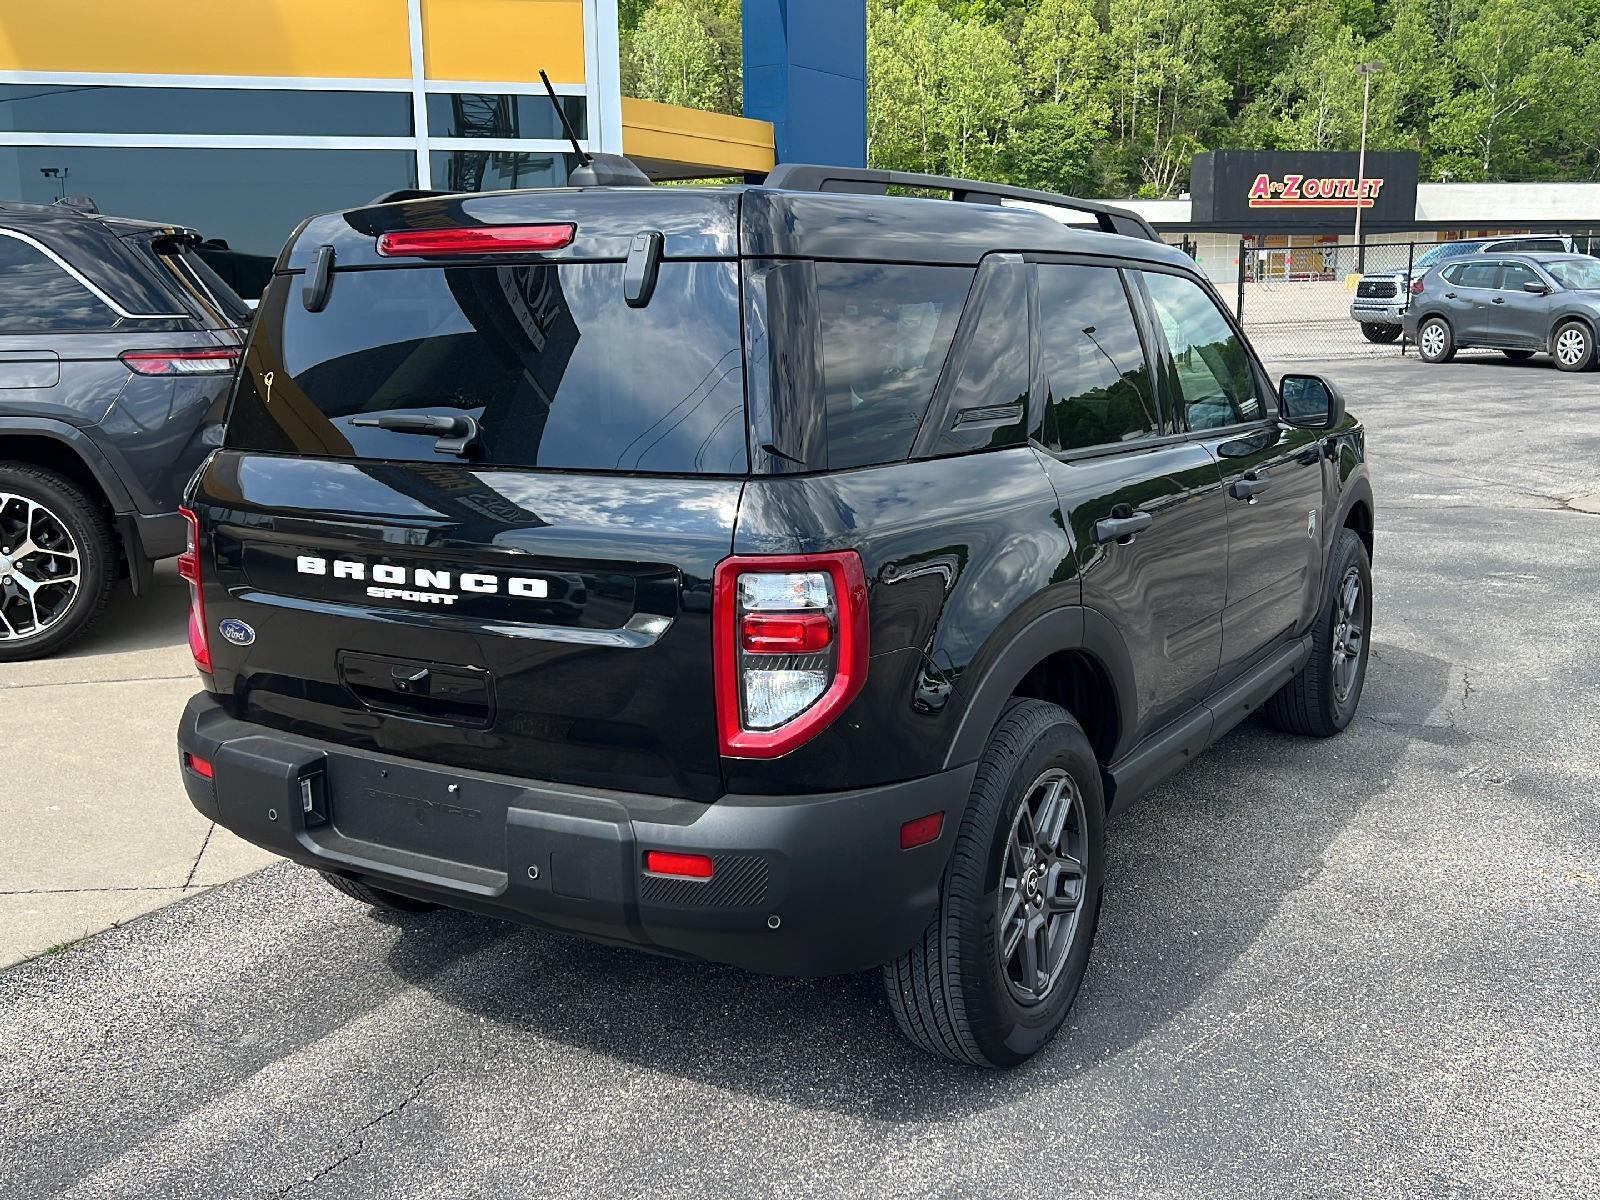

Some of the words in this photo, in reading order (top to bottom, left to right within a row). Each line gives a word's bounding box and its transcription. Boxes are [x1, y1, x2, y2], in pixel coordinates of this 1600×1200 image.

[1302, 178, 1384, 198] OUTLET
[296, 555, 549, 598] BRONCO
[366, 586, 459, 605] SPORT
